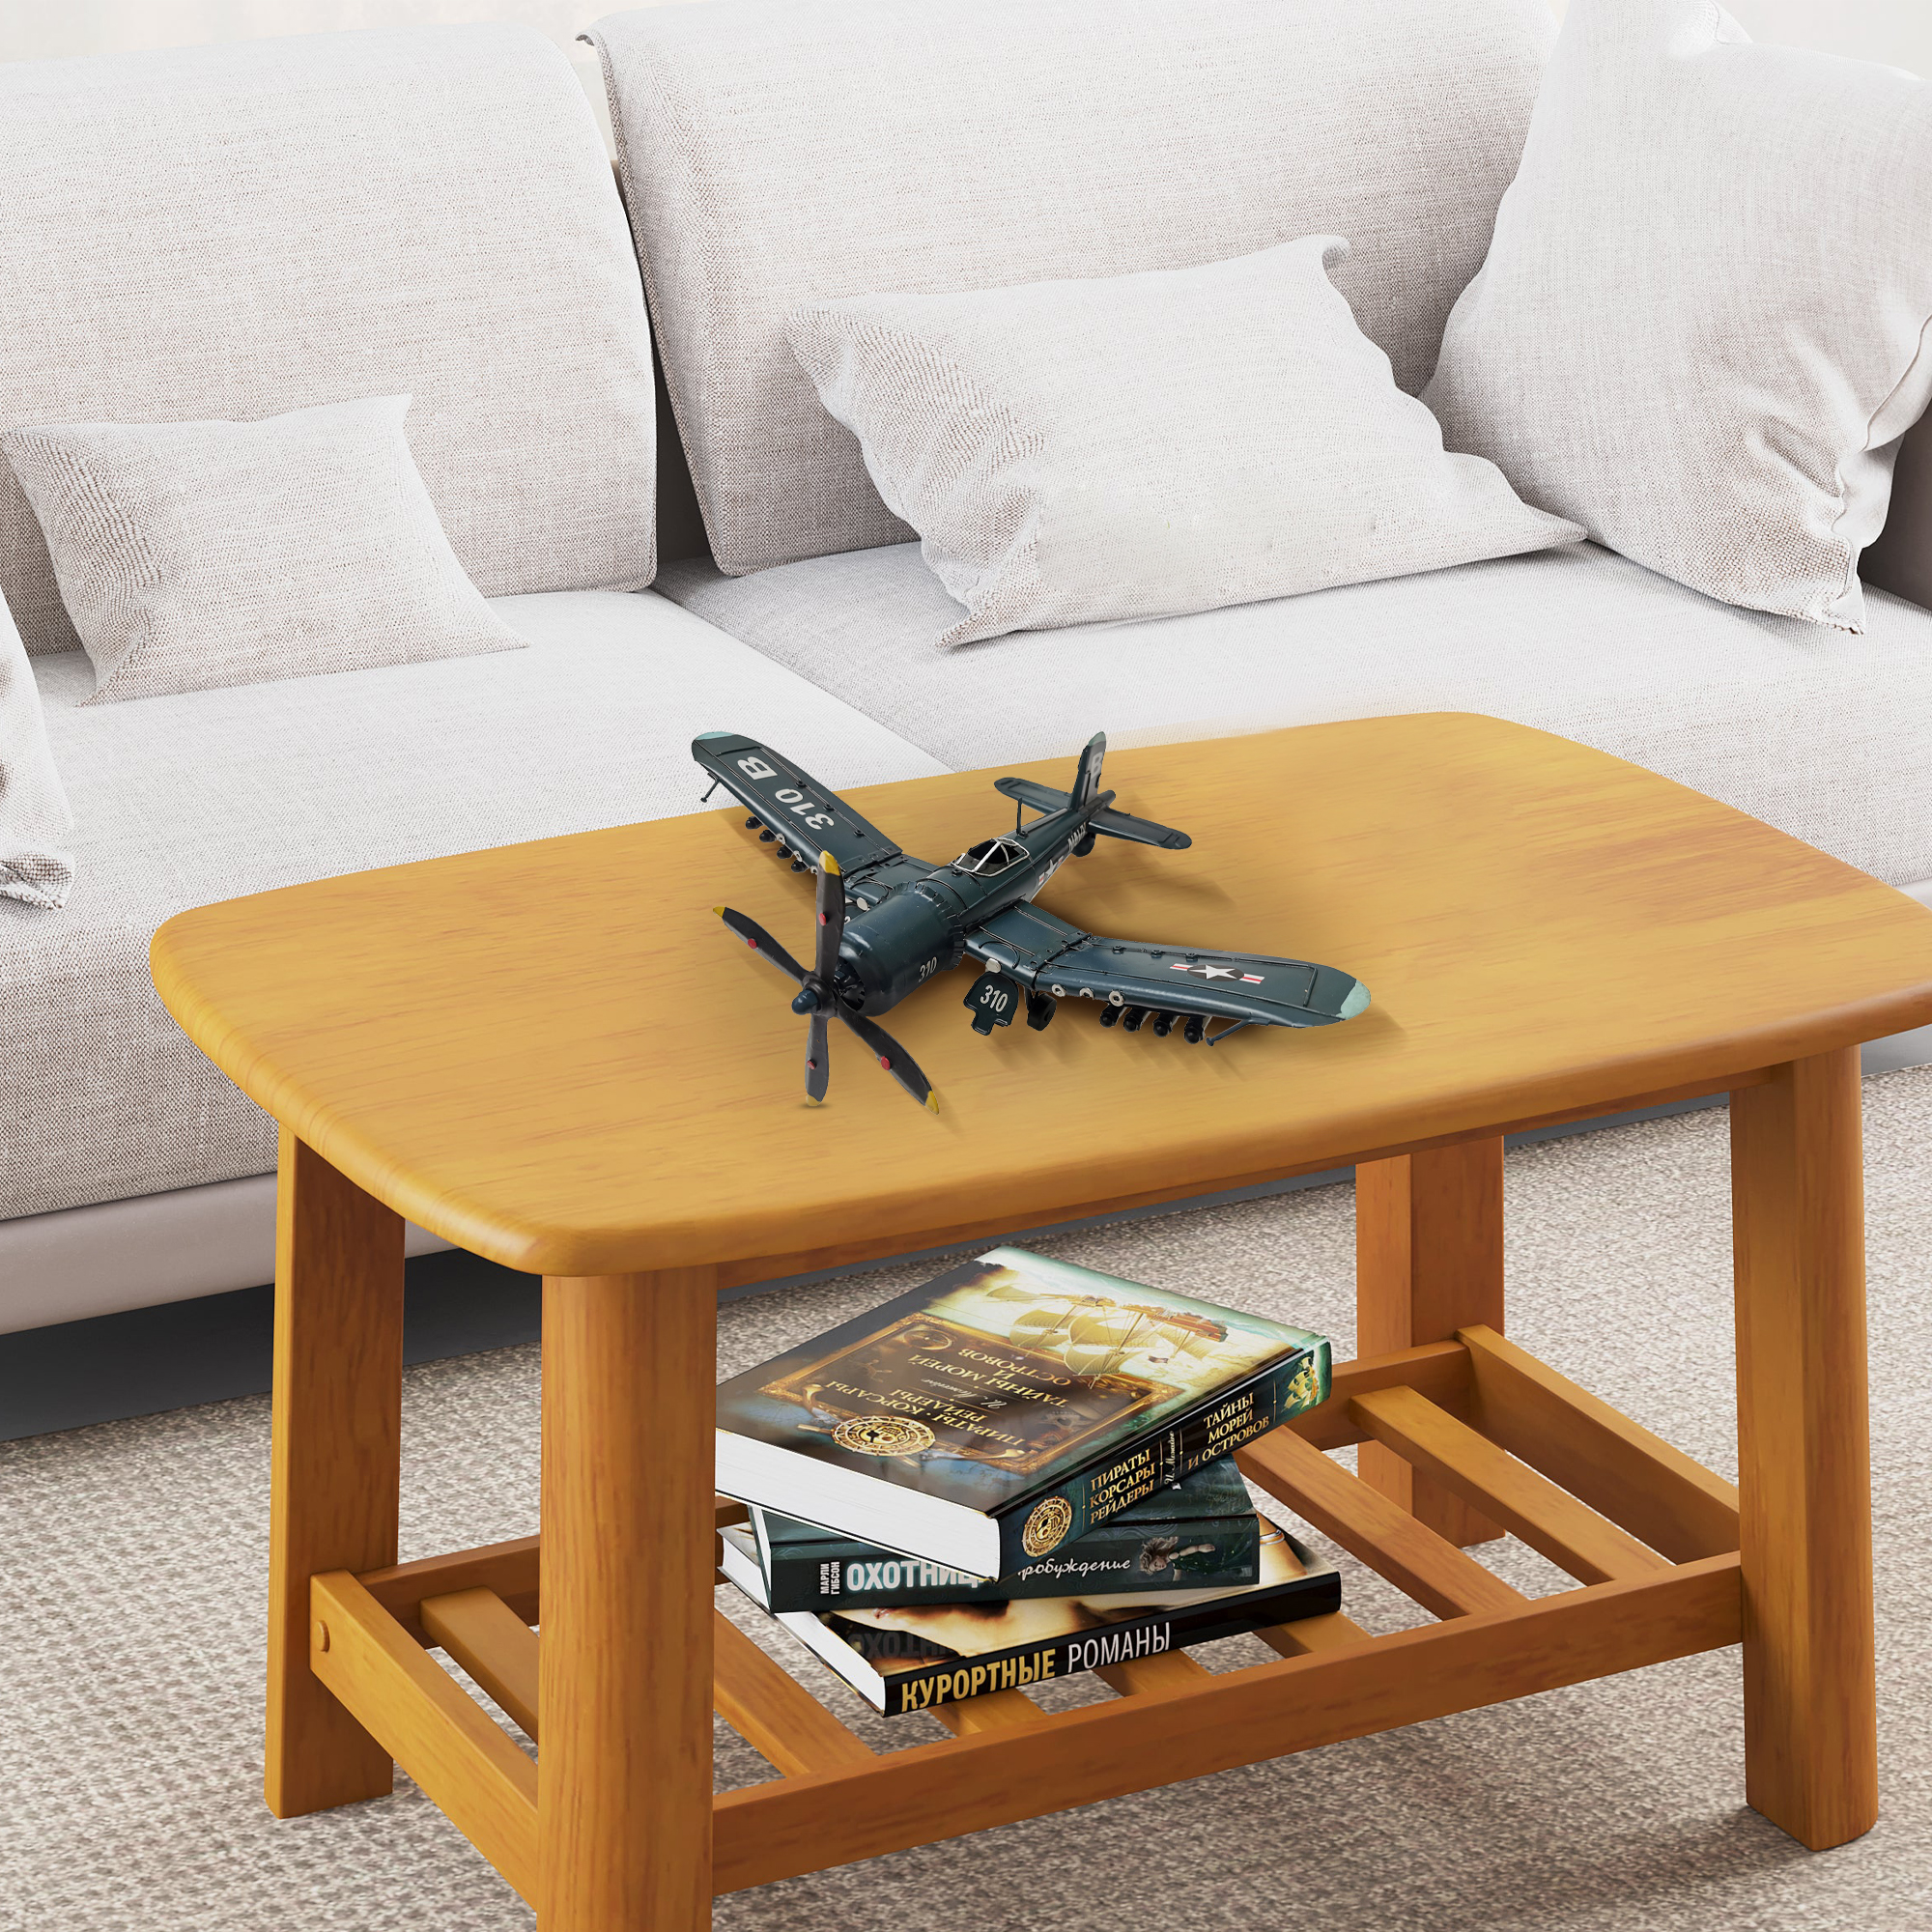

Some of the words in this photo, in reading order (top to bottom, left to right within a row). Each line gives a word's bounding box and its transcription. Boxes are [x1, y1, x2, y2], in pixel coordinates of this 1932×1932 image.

[737, 756, 778, 781] B
[1090, 752, 1104, 780] B
[775, 788, 835, 830] 310
[918, 956, 937, 983] 310
[980, 984, 1009, 1012] 310
[907, 1354, 987, 1382] МОРЕЙ
[957, 1348, 1071, 1386] ОСТРОВОВ
[992, 1369, 1011, 1380] И
[824, 1380, 925, 1415] КОРСАРЫ
[889, 1388, 987, 1423] РЕЙДЕРЫ
[984, 1376, 1069, 1407] ТАЙНЫ
[1203, 1391, 1255, 1430] ТАЙНЫ
[1208, 1406, 1253, 1444] МОРЕЙ
[932, 1413, 1026, 1446] ПИРАТЫ
[1187, 1454, 1200, 1470] И
[1202, 1415, 1270, 1463] ОСТРОВОВ
[1089, 1463, 1155, 1510] КОРСАРЫ
[1090, 1448, 1151, 1492] ПИРАТЫ
[1090, 1479, 1154, 1525] РЕЙДЕРЫ
[820, 1563, 830, 1594] МАРЛИ
[831, 1561, 840, 1595] ГИБСОН
[846, 1560, 984, 1591] ОХОТНИ
[1017, 1558, 1131, 1581] робуждение
[901, 1648, 1055, 1712] КУРОРТНЫЕ
[1067, 1622, 1170, 1673] РОМАНЫ
